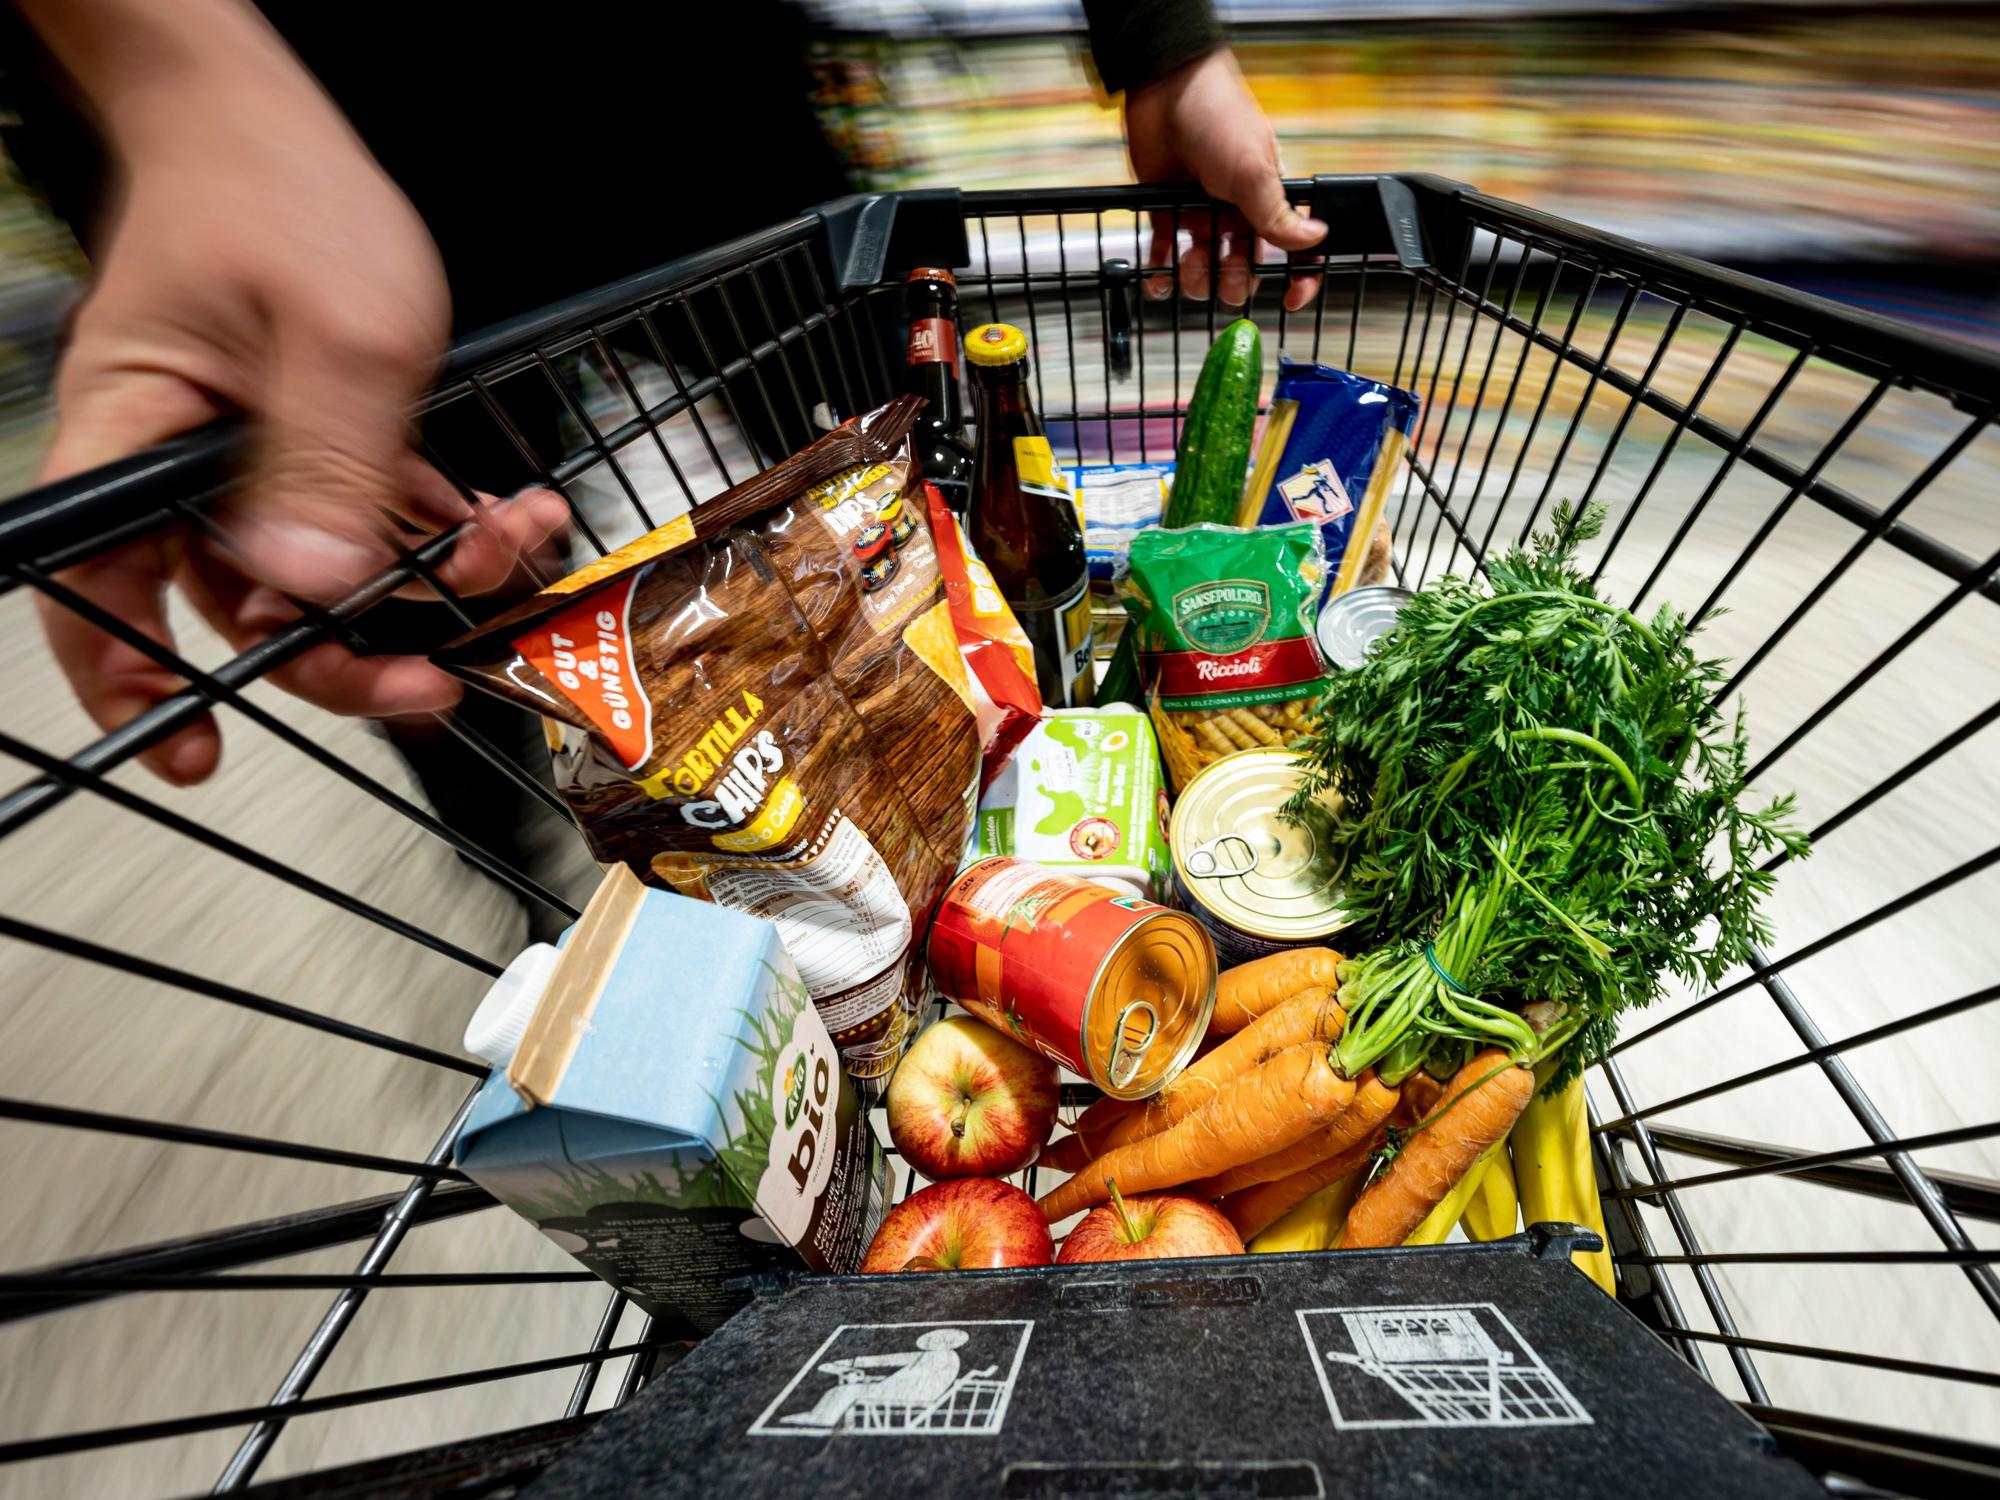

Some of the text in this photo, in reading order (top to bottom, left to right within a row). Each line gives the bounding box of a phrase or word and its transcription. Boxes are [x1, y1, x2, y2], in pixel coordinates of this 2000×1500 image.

[1180, 588, 1262, 613] SANSEPOLCRO
[1191, 608, 1255, 624] FACTORY
[551, 633, 581, 689] GUT
[578, 660, 599, 680] &
[596, 610, 633, 730] GÜNSTIG
[1196, 656, 1261, 681] Riccioli
[1163, 700, 1188, 709] SEMOLA
[1190, 695, 1241, 707] SELEZIONATA
[1255, 691, 1283, 701] GRANO
[1285, 687, 1307, 697] DURO
[634, 689, 764, 801] TORTILLA
[680, 730, 783, 829] CHIPS
[959, 876, 975, 893] 425
[787, 1066, 805, 1118] Arla
[787, 1057, 829, 1196] bio
[813, 1149, 842, 1247] FRISCHE BIO
[818, 1168, 844, 1250] VOLLMILCH
